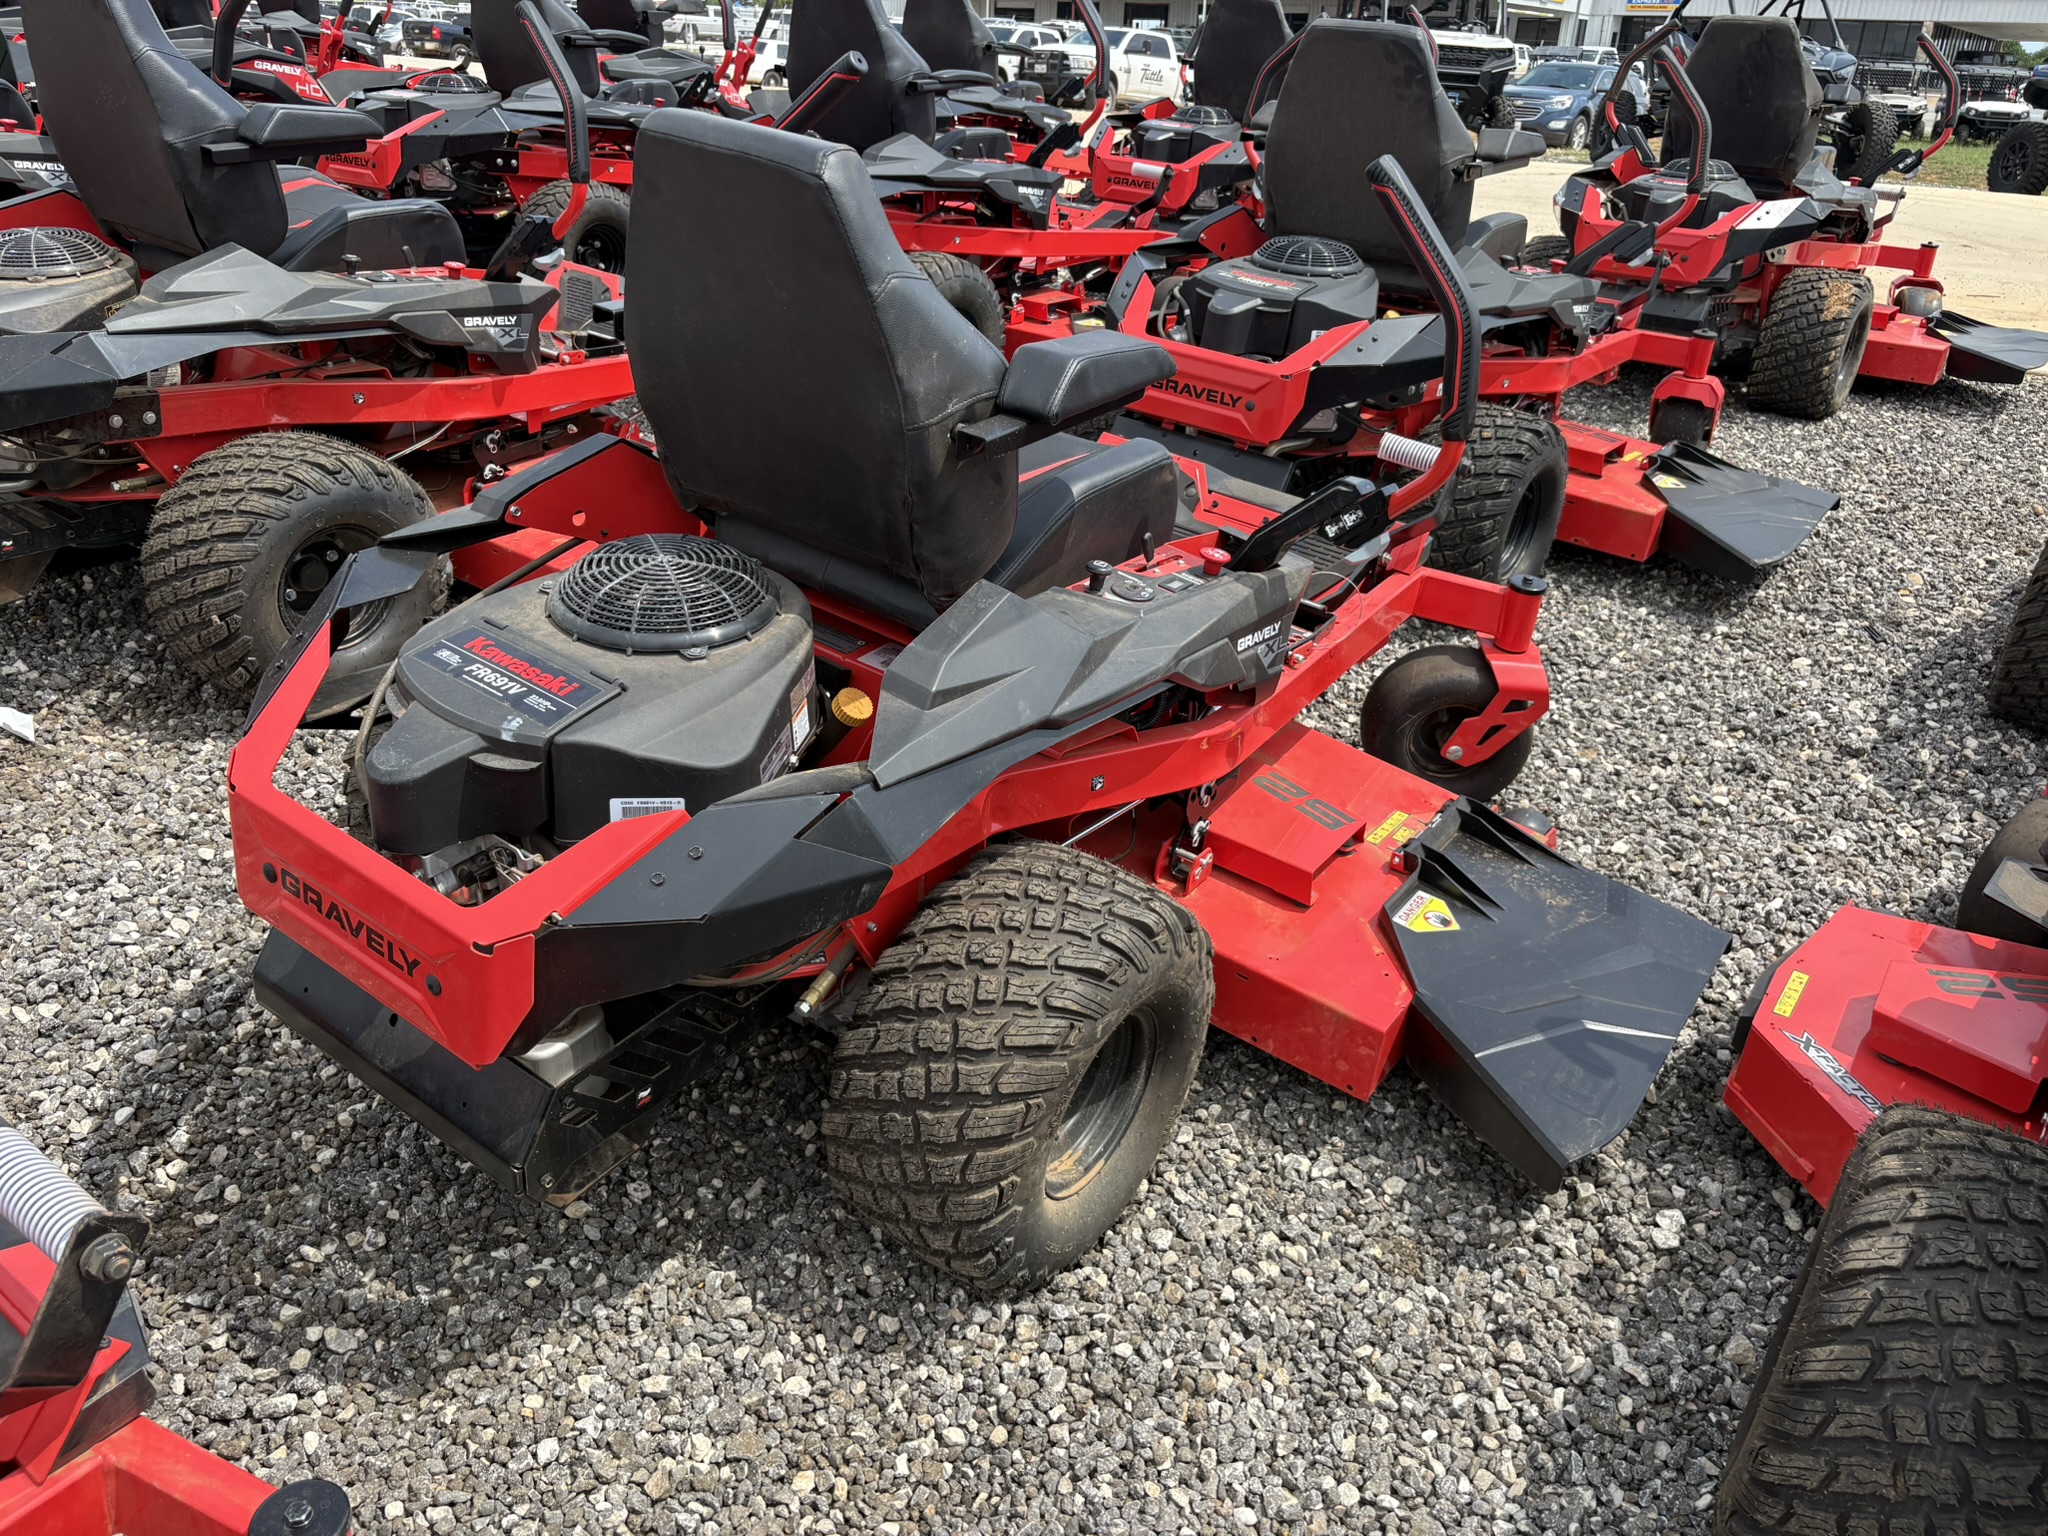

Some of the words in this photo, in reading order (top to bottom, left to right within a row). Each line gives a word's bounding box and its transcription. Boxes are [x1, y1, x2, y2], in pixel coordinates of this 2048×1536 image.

[254, 61, 302, 75] GRAVELY
[1140, 67, 1164, 84] Tuttle
[296, 82, 323, 97] HD
[330, 154, 370, 168] GRAVELY
[1113, 176, 1159, 190] GRAVEL
[464, 315, 518, 327] GRAVELY
[499, 328, 529, 339] XL
[1150, 379, 1243, 408] GRAVELY
[1237, 620, 1282, 652] GRAVELY
[1263, 637, 1287, 659] XL
[463, 635, 581, 697] Kawasaki
[463, 663, 528, 695] FR691V
[1397, 893, 1426, 922] DANGER
[281, 867, 422, 978] GRAVELY
